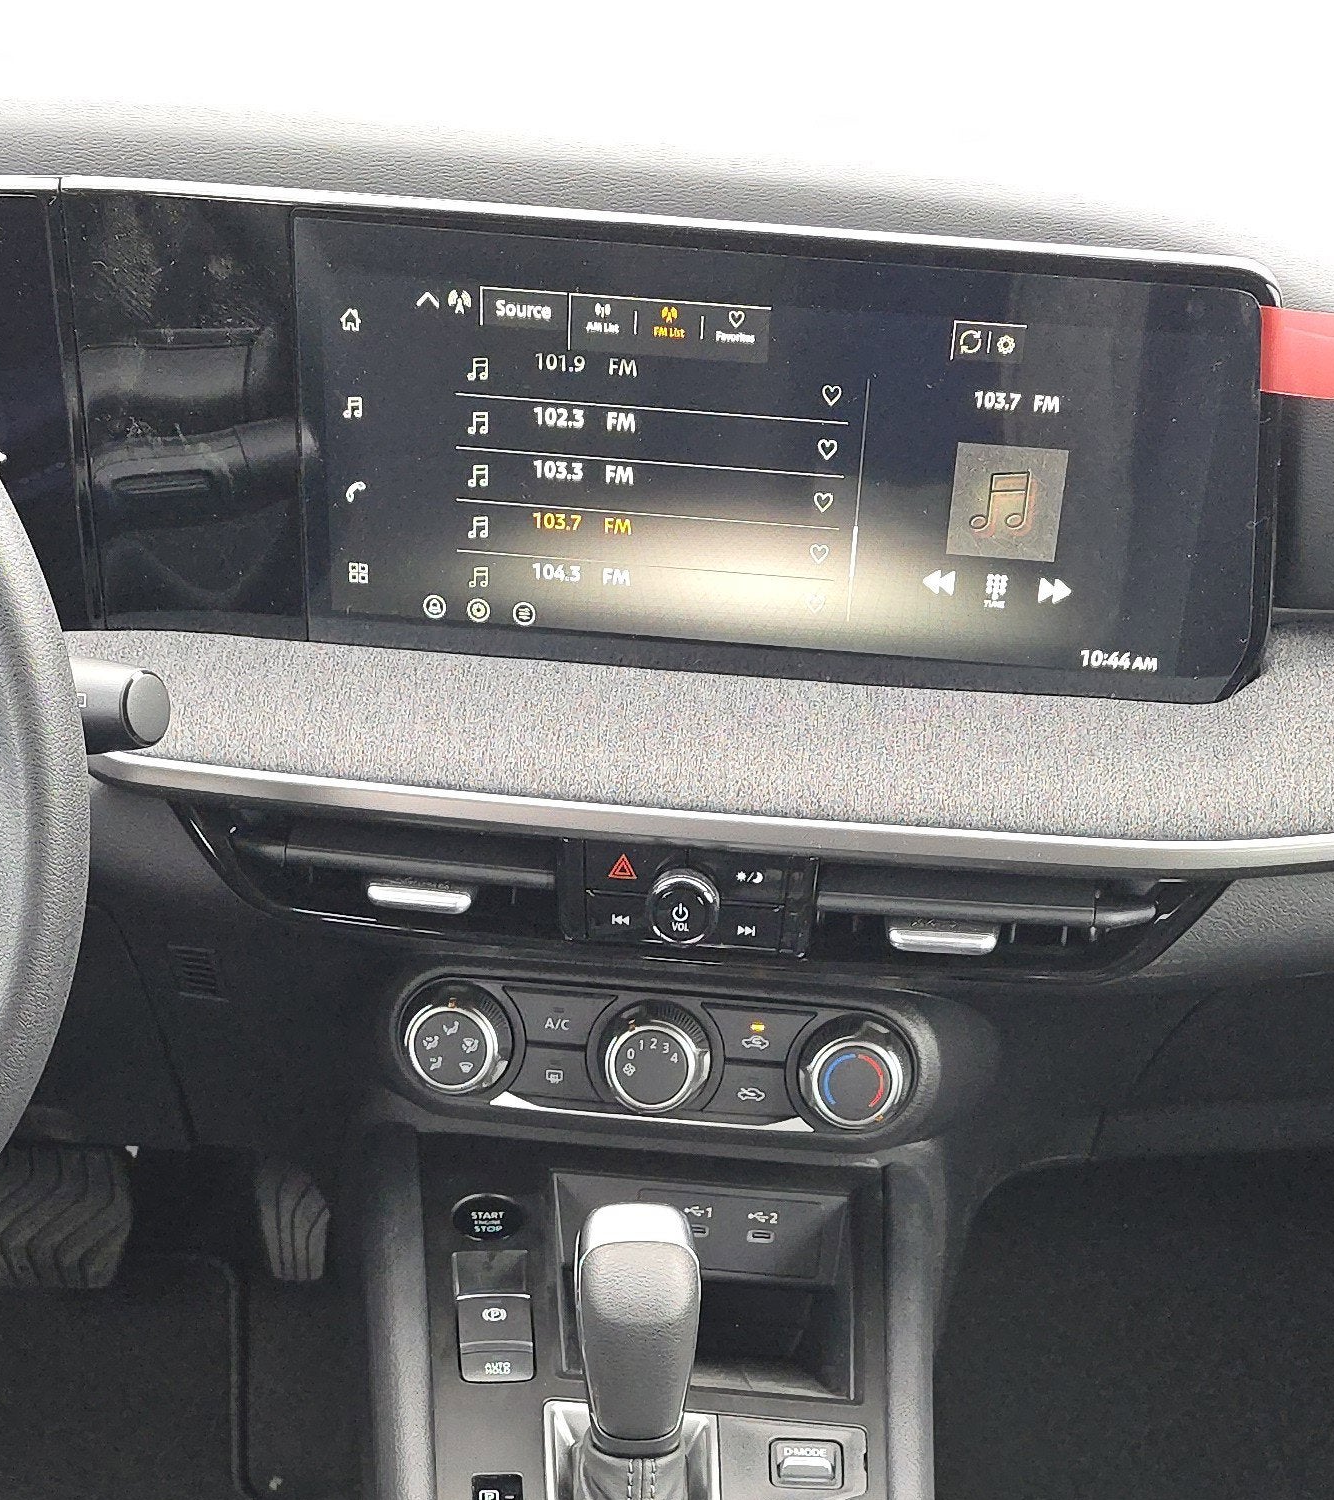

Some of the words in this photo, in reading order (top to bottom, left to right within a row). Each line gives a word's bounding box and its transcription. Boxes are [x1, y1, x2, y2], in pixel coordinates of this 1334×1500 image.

[495, 301, 552, 320] Source
[535, 352, 586, 372] 101.9
[609, 358, 637, 378] FM
[974, 390, 1022, 410] 103.7
[1033, 395, 1060, 413] FM
[534, 407, 585, 429] 102.3
[606, 412, 637, 433] FM
[534, 460, 584, 481] 103.3
[605, 465, 634, 485] FM
[532, 512, 582, 531] 103.7
[604, 518, 632, 536] FM
[532, 563, 581, 583] 104.3
[602, 568, 631, 586] FM
[672, 921, 689, 932] VOL
[544, 1017, 570, 1031] A/C
[639, 1039, 644, 1050] 1
[650, 1038, 657, 1049] 2
[662, 1043, 670, 1053] 3
[670, 1053, 678, 1063] 4
[470, 1211, 505, 1220] START
[474, 1225, 503, 1233] STOP
[485, 1361, 511, 1370] AUTO
